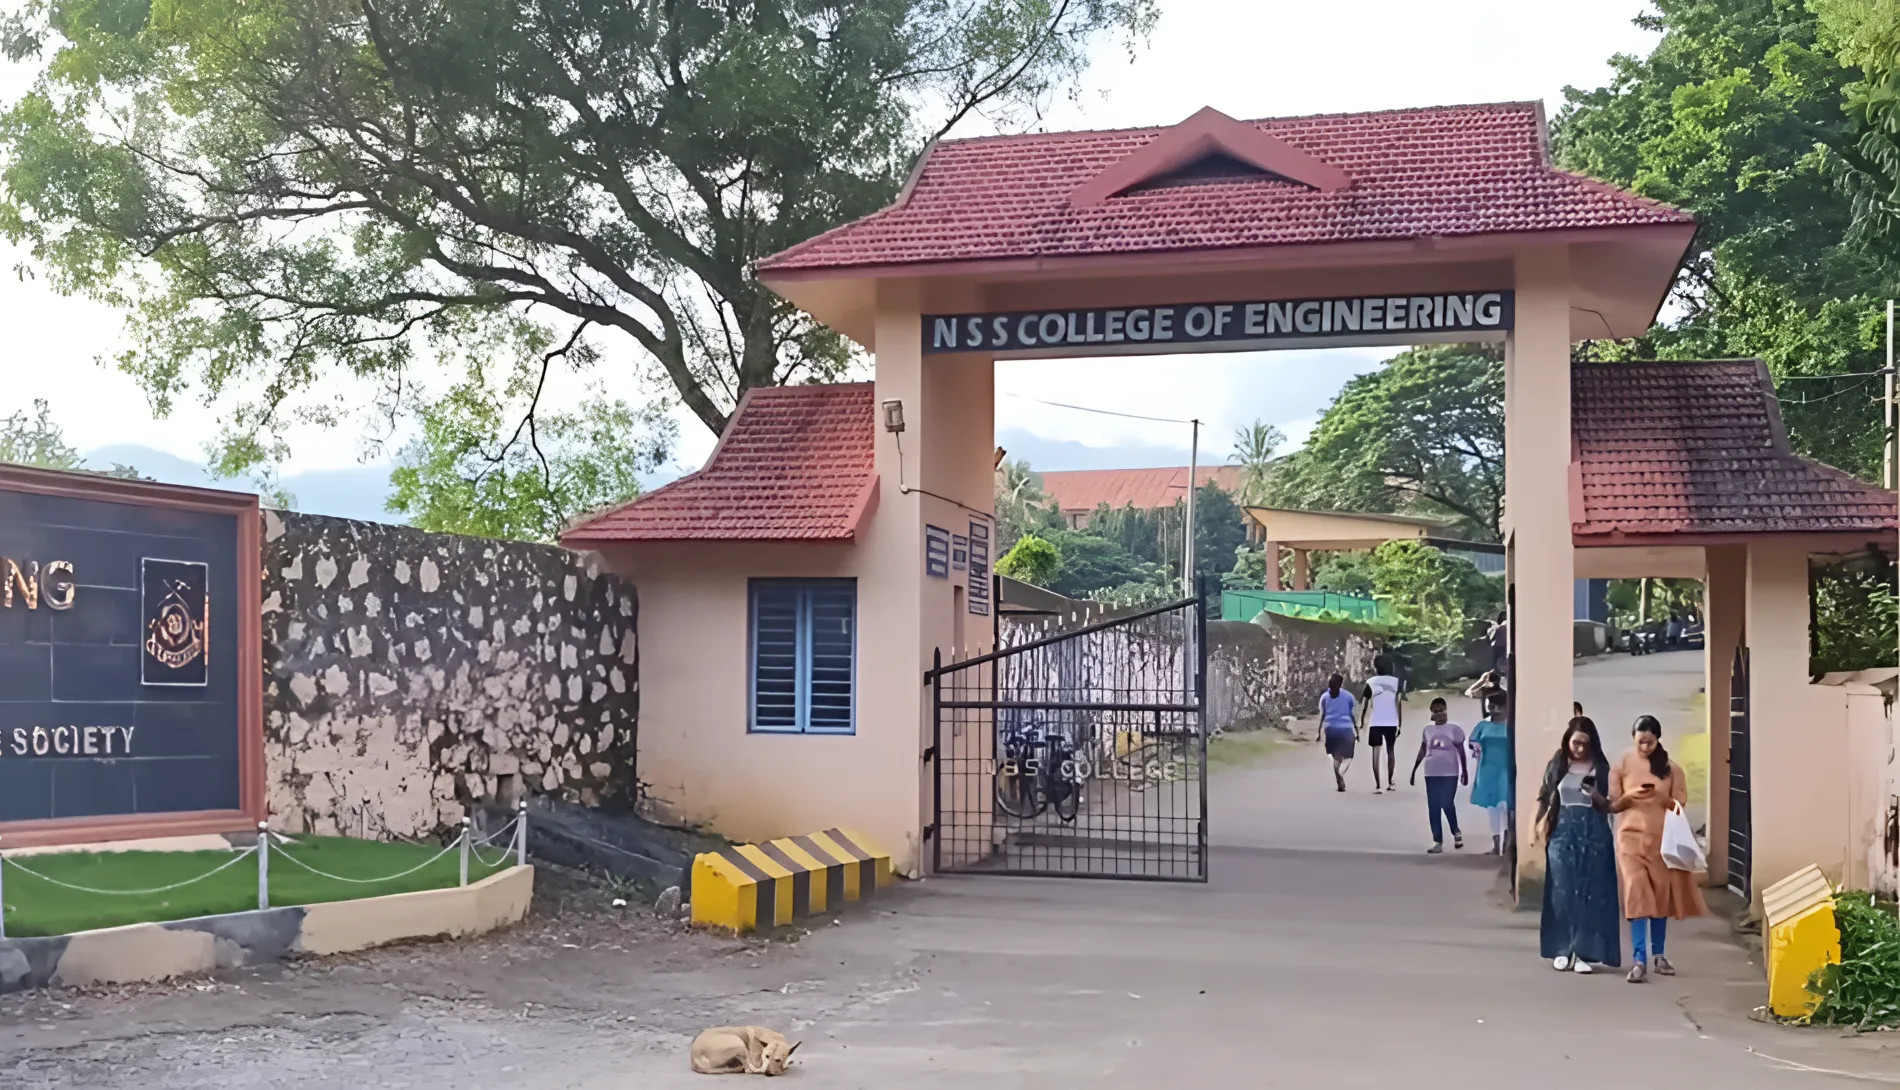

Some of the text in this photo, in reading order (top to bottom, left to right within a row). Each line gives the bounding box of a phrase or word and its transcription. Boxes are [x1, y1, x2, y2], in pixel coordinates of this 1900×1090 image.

[933, 293, 1501, 348] N S S COLLEGE OF ENGINEERING
[10, 725, 134, 756] SOCIETY
